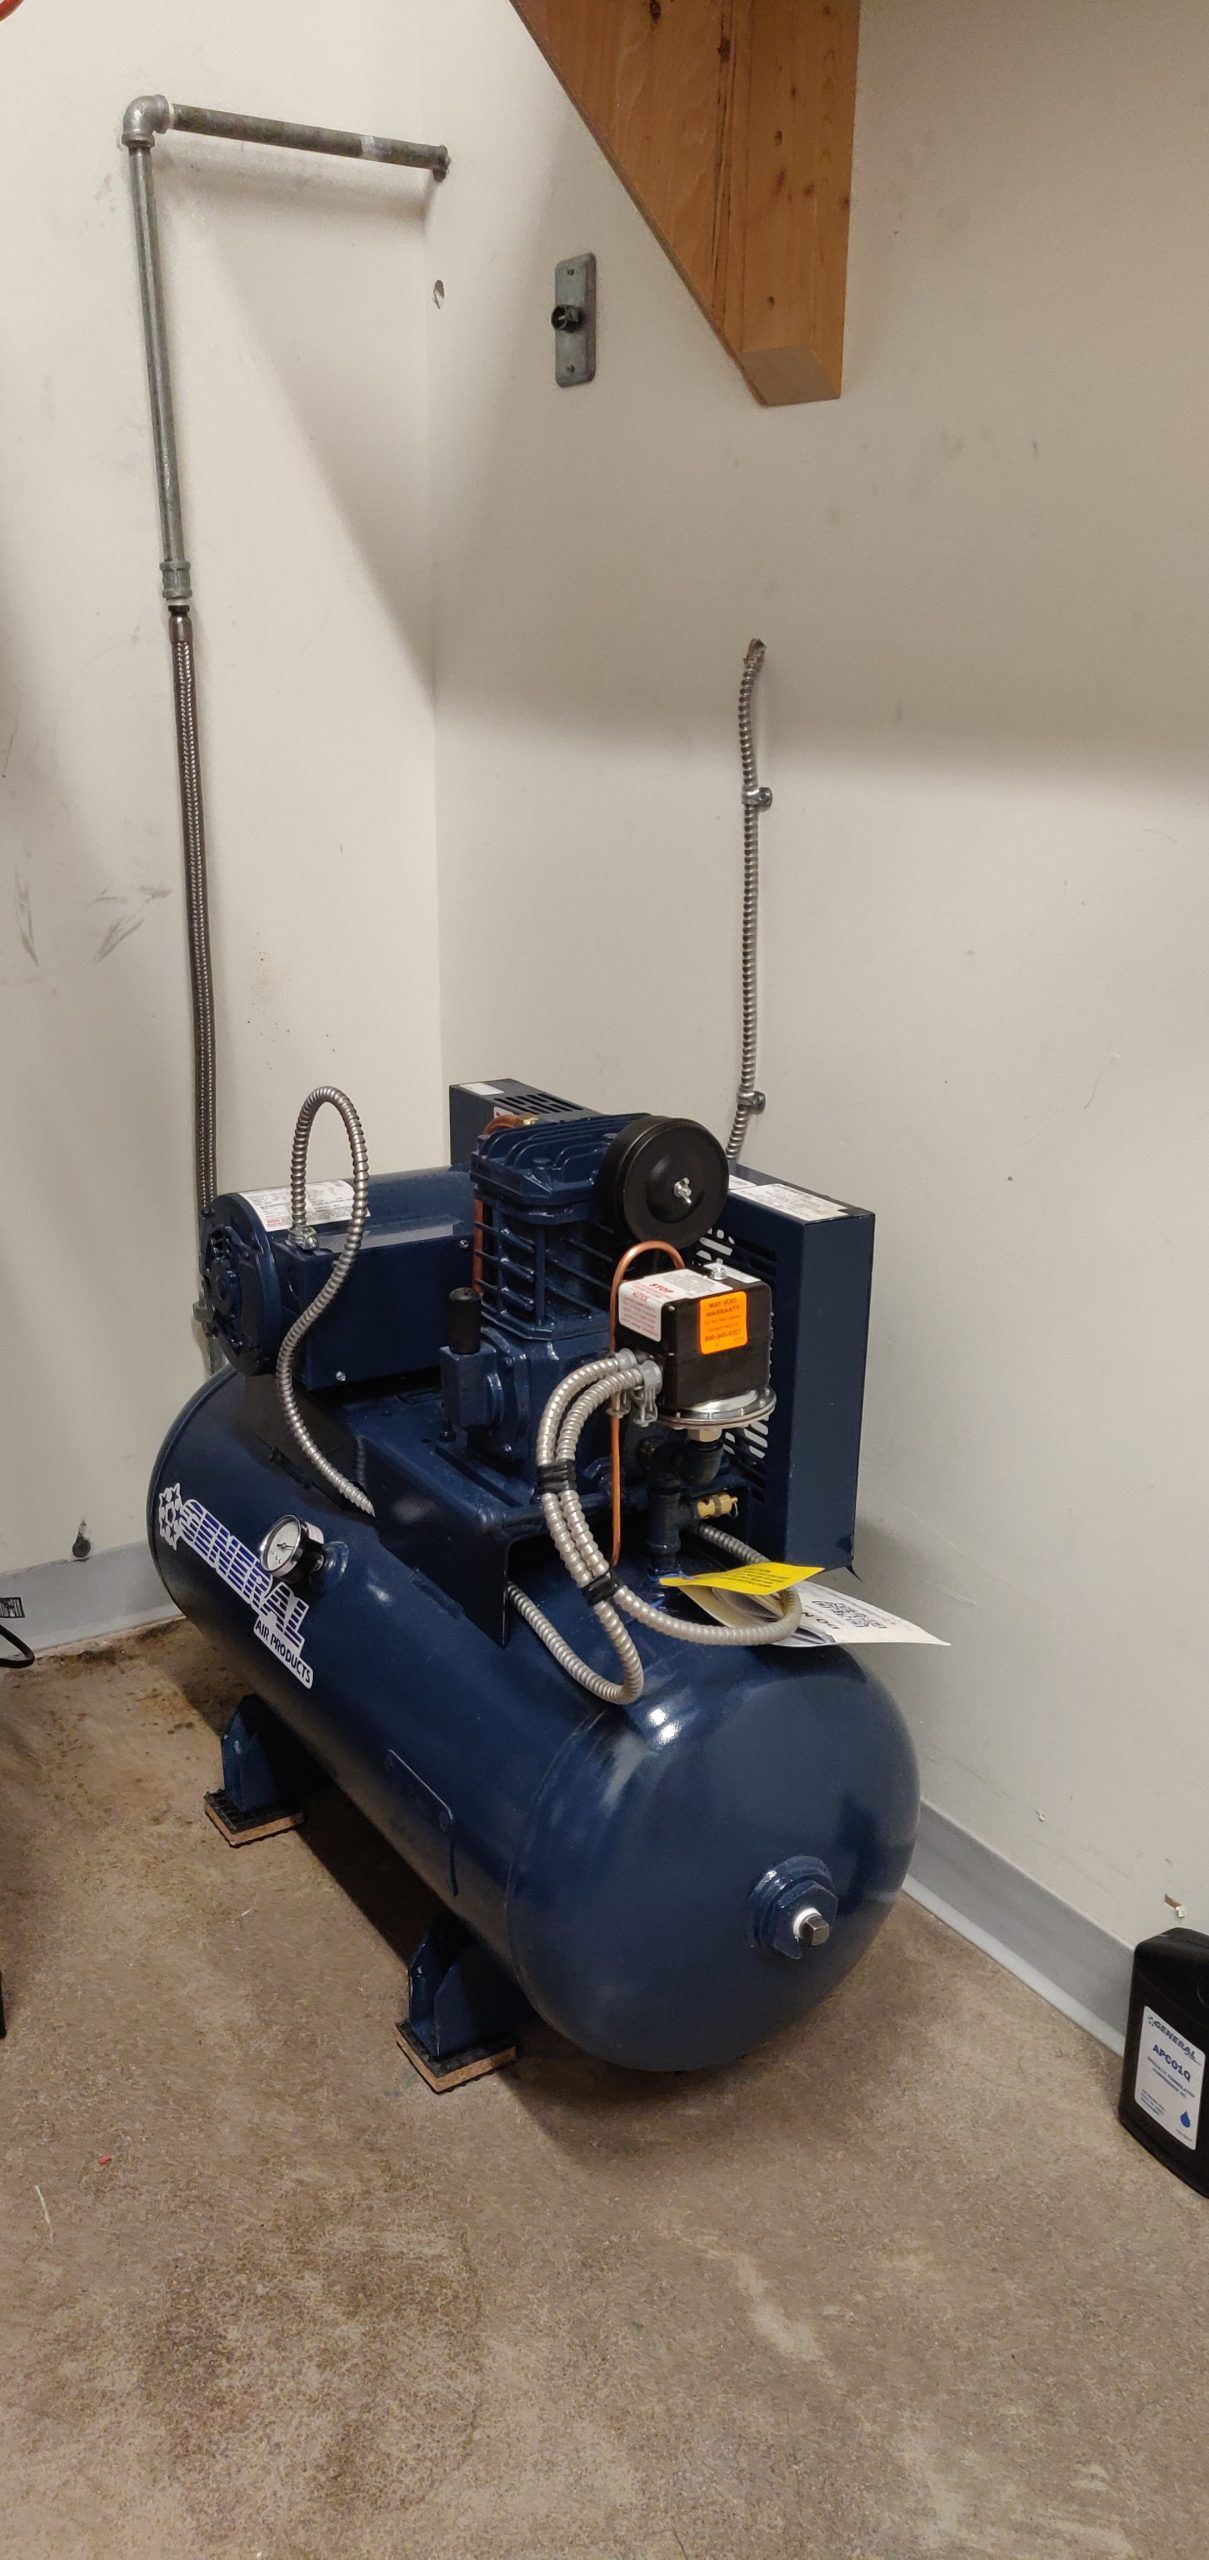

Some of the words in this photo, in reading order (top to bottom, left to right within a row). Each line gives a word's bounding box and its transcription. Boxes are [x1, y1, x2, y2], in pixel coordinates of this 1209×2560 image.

[706, 1305, 740, 1317] WARRANTY
[180, 1499, 308, 1648] GENERAL
[255, 1618, 270, 1641] AIR
[270, 1633, 312, 1684] PRODUCTS
[1153, 2020, 1197, 2060] GENERAL
